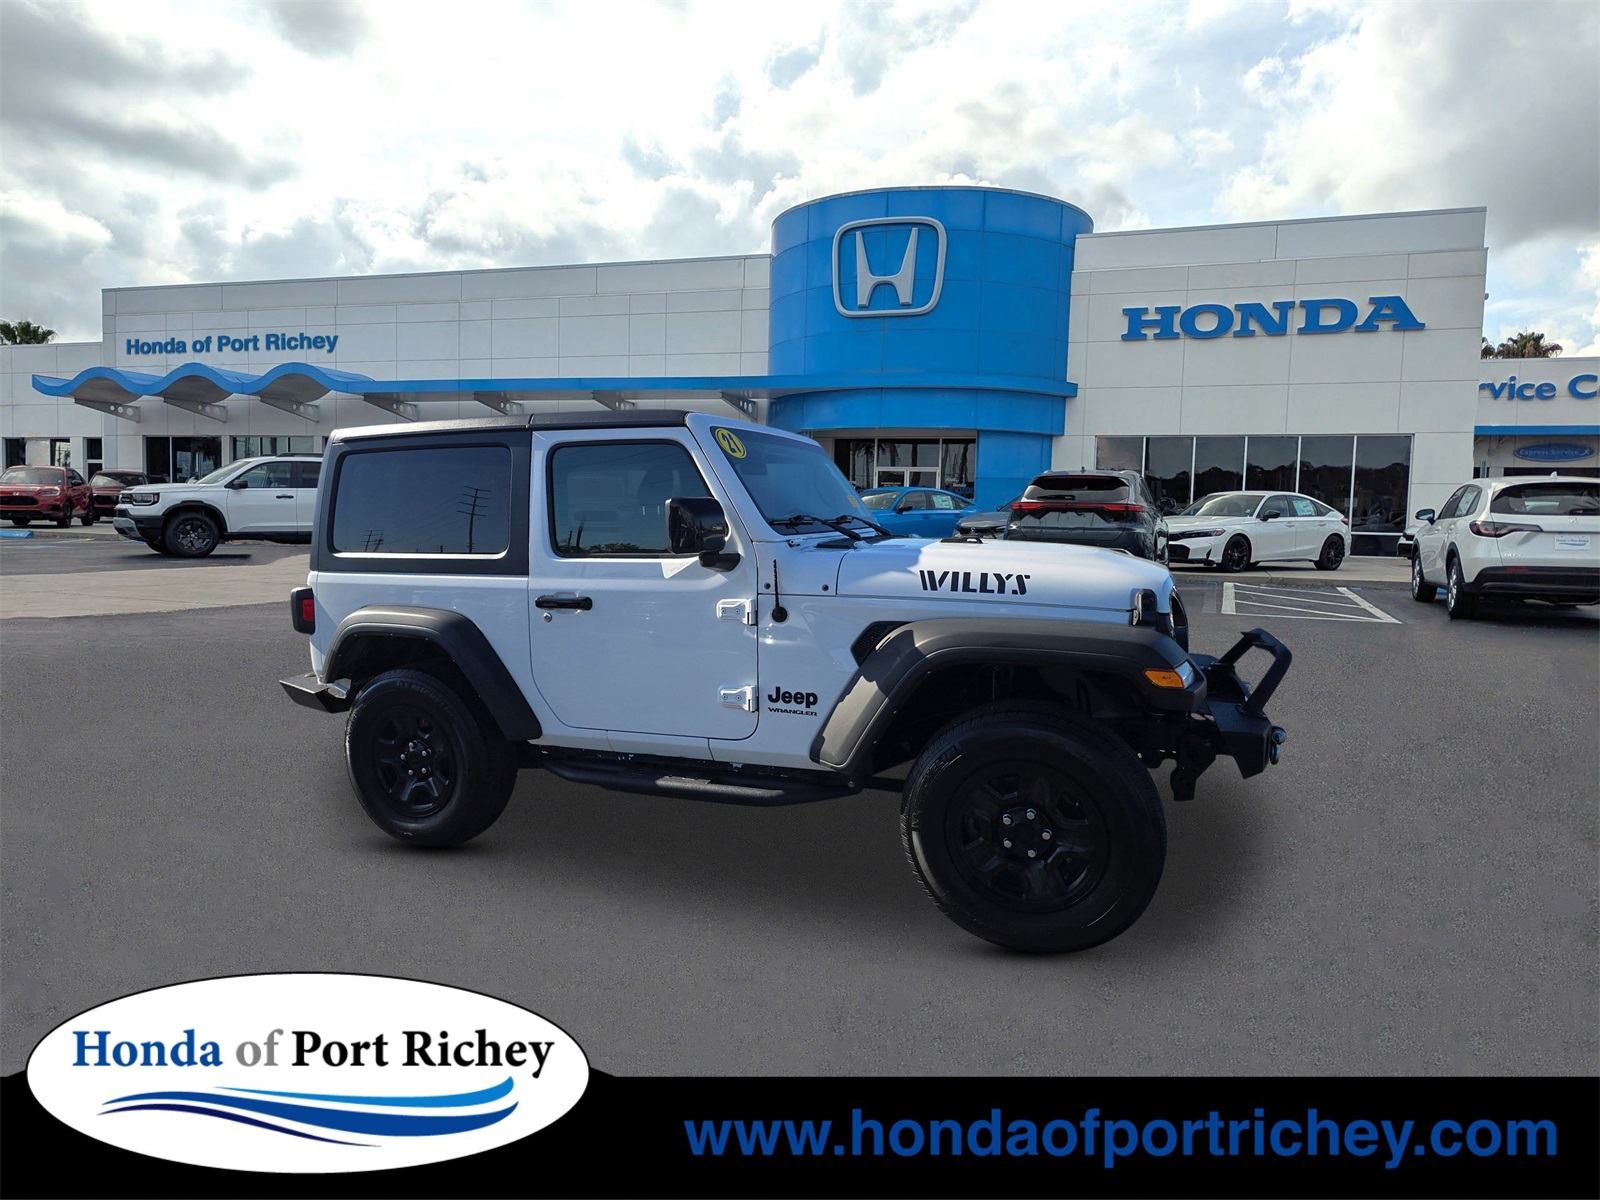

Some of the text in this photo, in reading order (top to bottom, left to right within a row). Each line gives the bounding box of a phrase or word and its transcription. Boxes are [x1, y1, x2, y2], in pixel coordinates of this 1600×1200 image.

[1121, 296, 1426, 341] HONDA
[126, 333, 339, 355] Honda of Port Richey
[723, 432, 742, 454] 21
[919, 570, 1031, 595] WILLYS
[767, 686, 818, 708] Jeep
[767, 706, 818, 716] WRANGLER
